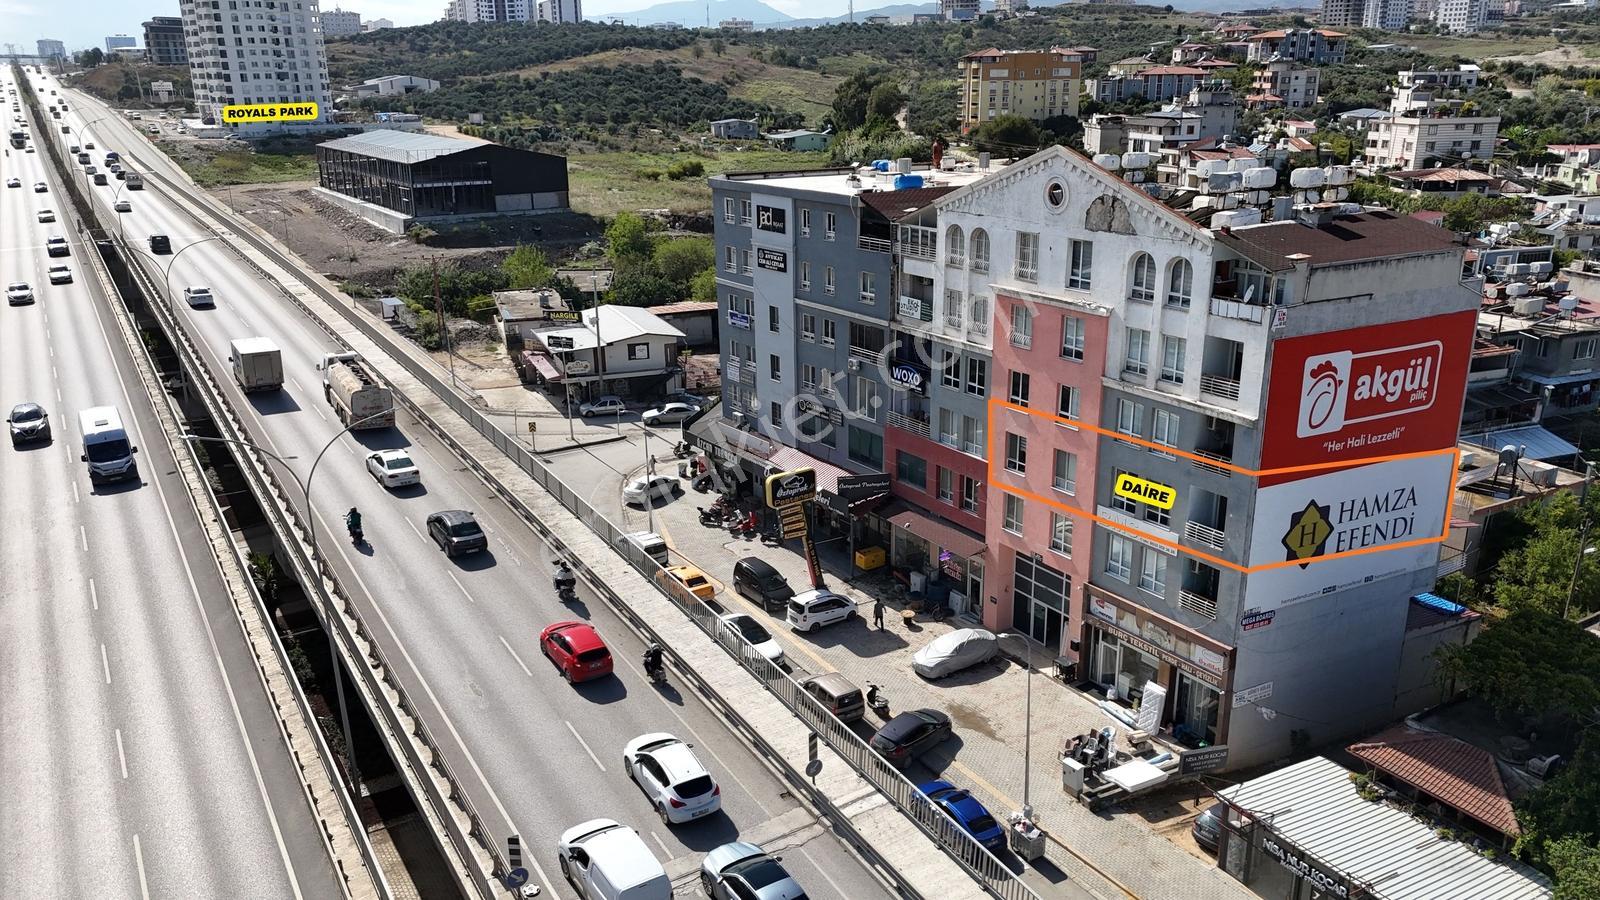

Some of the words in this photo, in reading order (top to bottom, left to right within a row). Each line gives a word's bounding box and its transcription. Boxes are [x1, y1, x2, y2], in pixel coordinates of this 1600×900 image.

[764, 254, 784, 262] AVUKAT
[892, 366, 920, 386] WOXO
[1354, 355, 1432, 403] akgül
[1409, 389, 1428, 403] piliç
[1347, 434, 1366, 449] Hali
[777, 484, 809, 498] Öztoprak
[1337, 485, 1418, 525] HAMZA
[1298, 522, 1318, 548] H
[1335, 511, 1415, 553] EFENDİ
[1108, 627, 1129, 643] BURÇ
[1129, 637, 1160, 658] TEKSTİL
[1286, 852, 1310, 875] NUR
[1310, 867, 1348, 899] KOCAR
